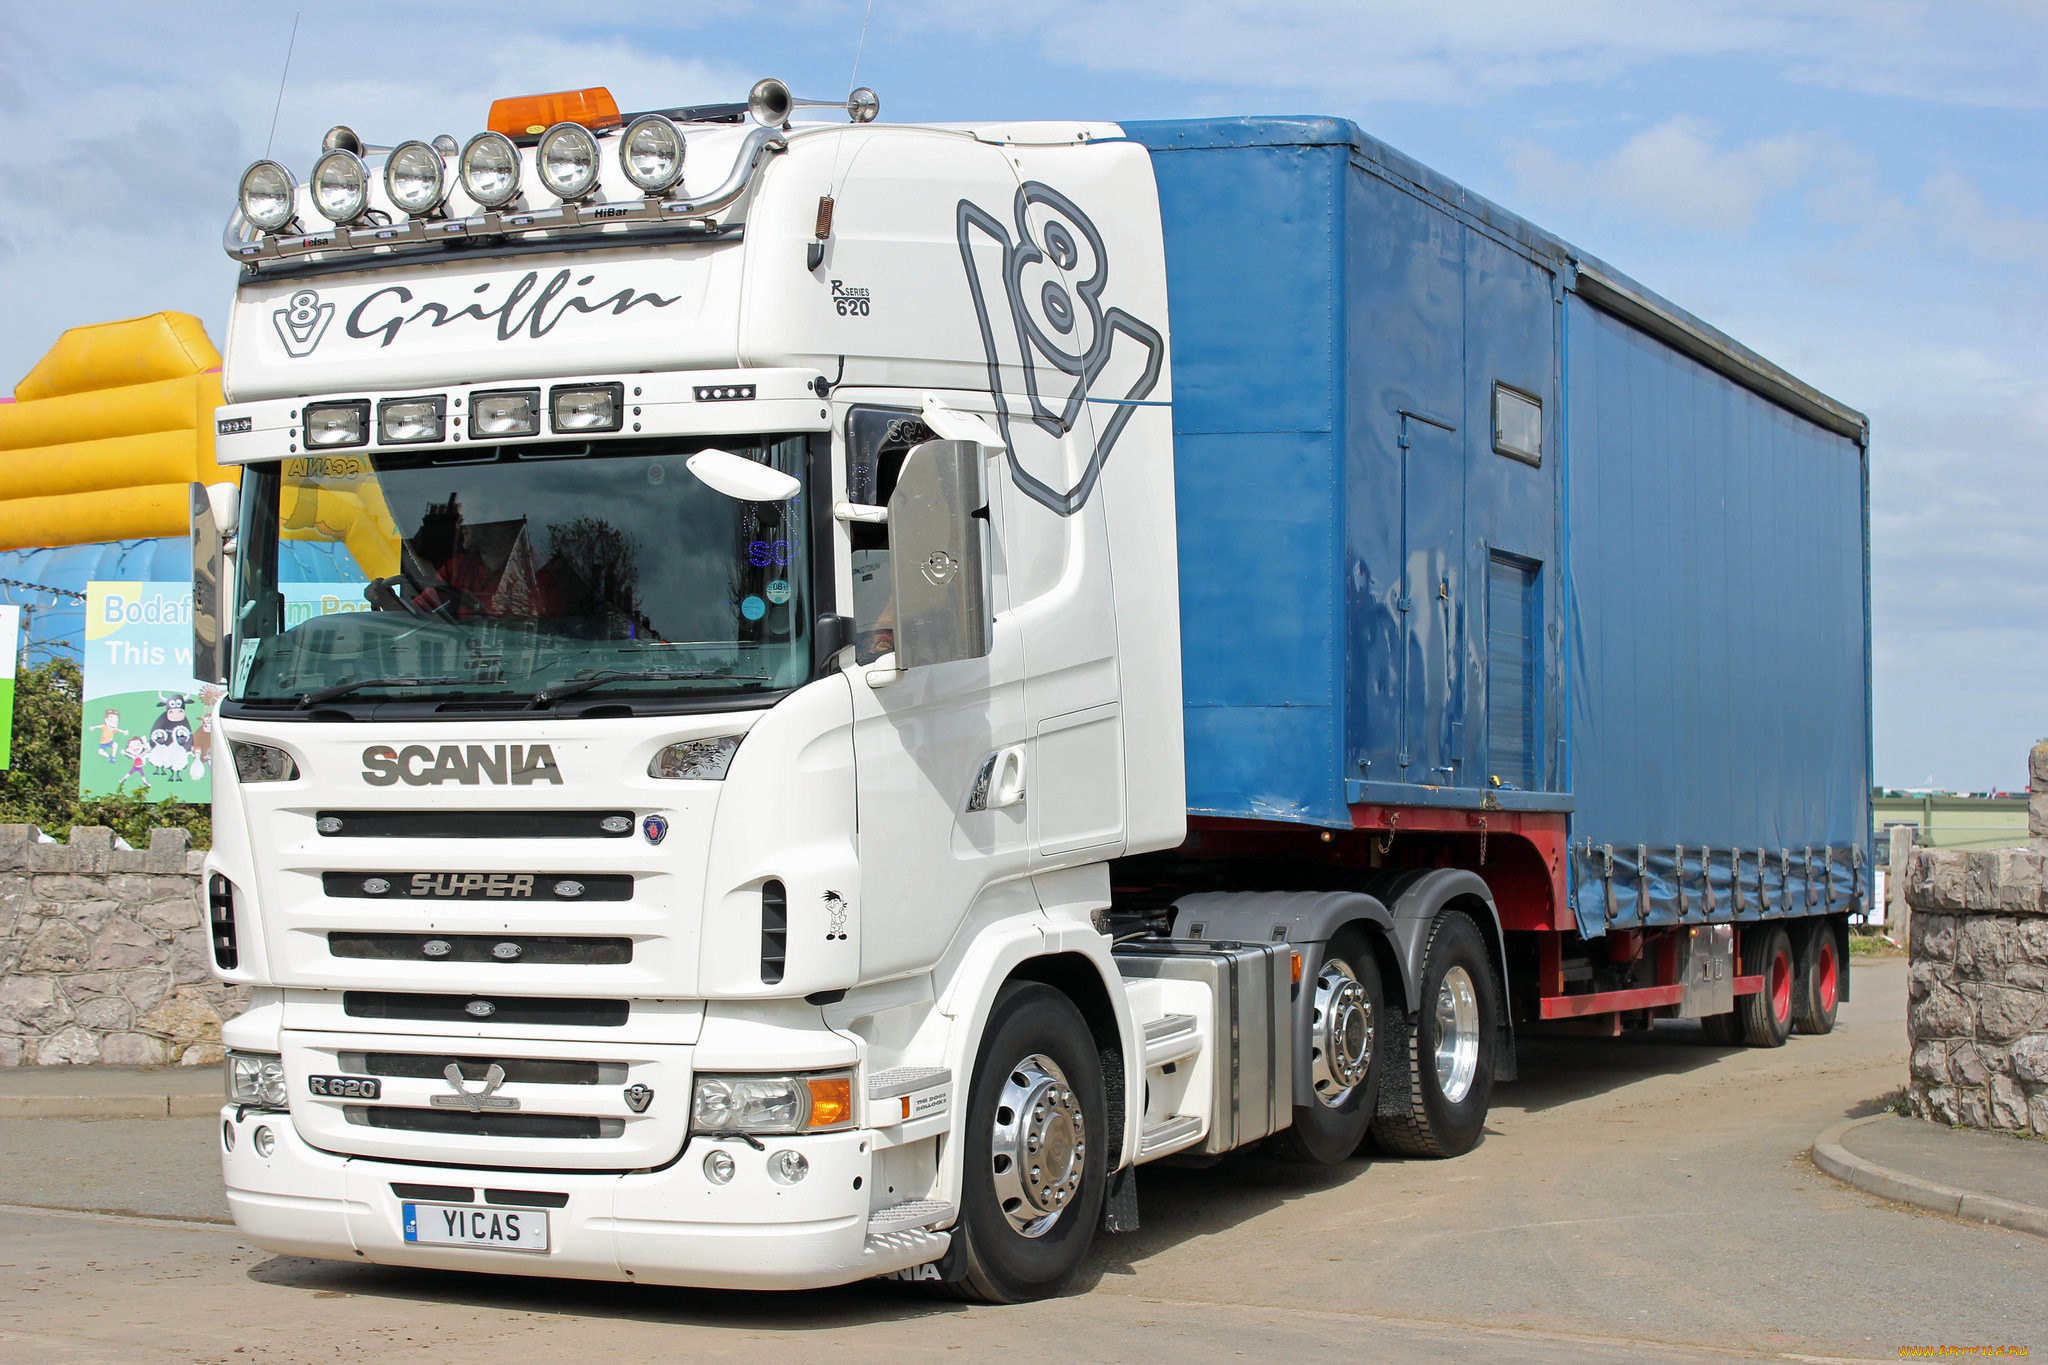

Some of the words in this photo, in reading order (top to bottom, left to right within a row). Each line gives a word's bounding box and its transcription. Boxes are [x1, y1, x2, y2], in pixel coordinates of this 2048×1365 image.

[594, 208, 628, 218] HiBar
[845, 287, 870, 296] SERIES
[345, 269, 682, 348] Griffin
[836, 300, 870, 316] 620
[104, 594, 193, 624] Bodaf
[105, 641, 165, 665] This
[362, 745, 564, 786] SCANIA
[410, 873, 535, 897] SUPER
